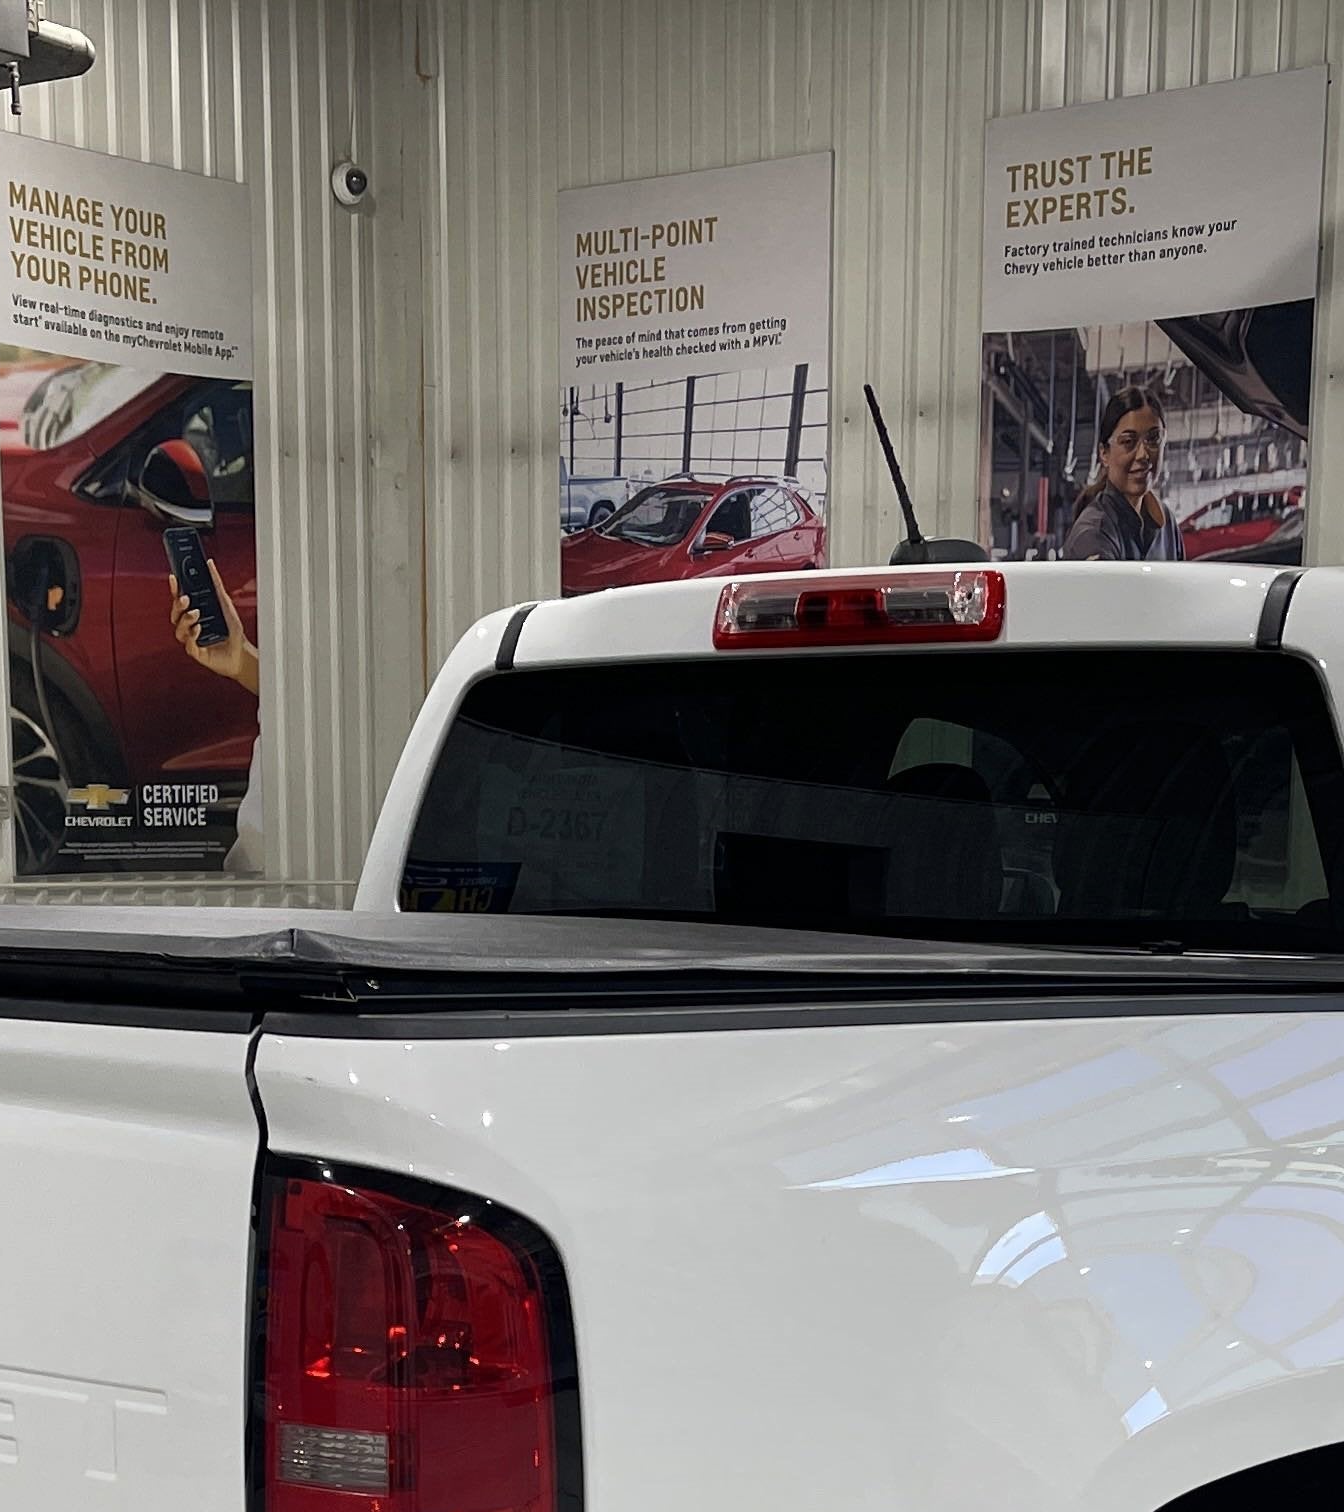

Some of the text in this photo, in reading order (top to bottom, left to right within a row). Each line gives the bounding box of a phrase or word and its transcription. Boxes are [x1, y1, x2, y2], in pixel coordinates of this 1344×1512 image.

[1006, 146, 1153, 193] TRUST THE
[9, 180, 167, 241] MANAGE YOUR
[1006, 186, 1136, 229] EXPERTS.
[9, 215, 170, 274] VEHICLE FROM
[575, 216, 718, 258] MULTI-POINT
[1004, 218, 1238, 258] Factory trained technicians know your
[10, 250, 158, 305] YOUR PHONE.
[575, 255, 667, 290] VEHICLE
[1004, 242, 1208, 277] Chevy vehicle better than anyone.
[12, 293, 225, 341] View real-time diagnostics and enjoy remote
[576, 284, 705, 322] INSPECTION
[44, 320, 88, 338] available
[90, 328, 103, 340] on
[104, 329, 121, 343] the
[122, 334, 183, 353] myChevrolet
[183, 340, 213, 357] Mobile
[575, 316, 787, 351] The peace of mind that comes from getting
[575, 354, 598, 369] your
[599, 348, 640, 363] vehicle's
[642, 345, 674, 359] health
[675, 340, 717, 356] checked
[718, 338, 742, 351] with
[744, 339, 751, 349] a
[142, 784, 219, 804] CERTIFIED
[64, 816, 133, 828] CHEVROLET
[143, 807, 207, 827] SERVICE
